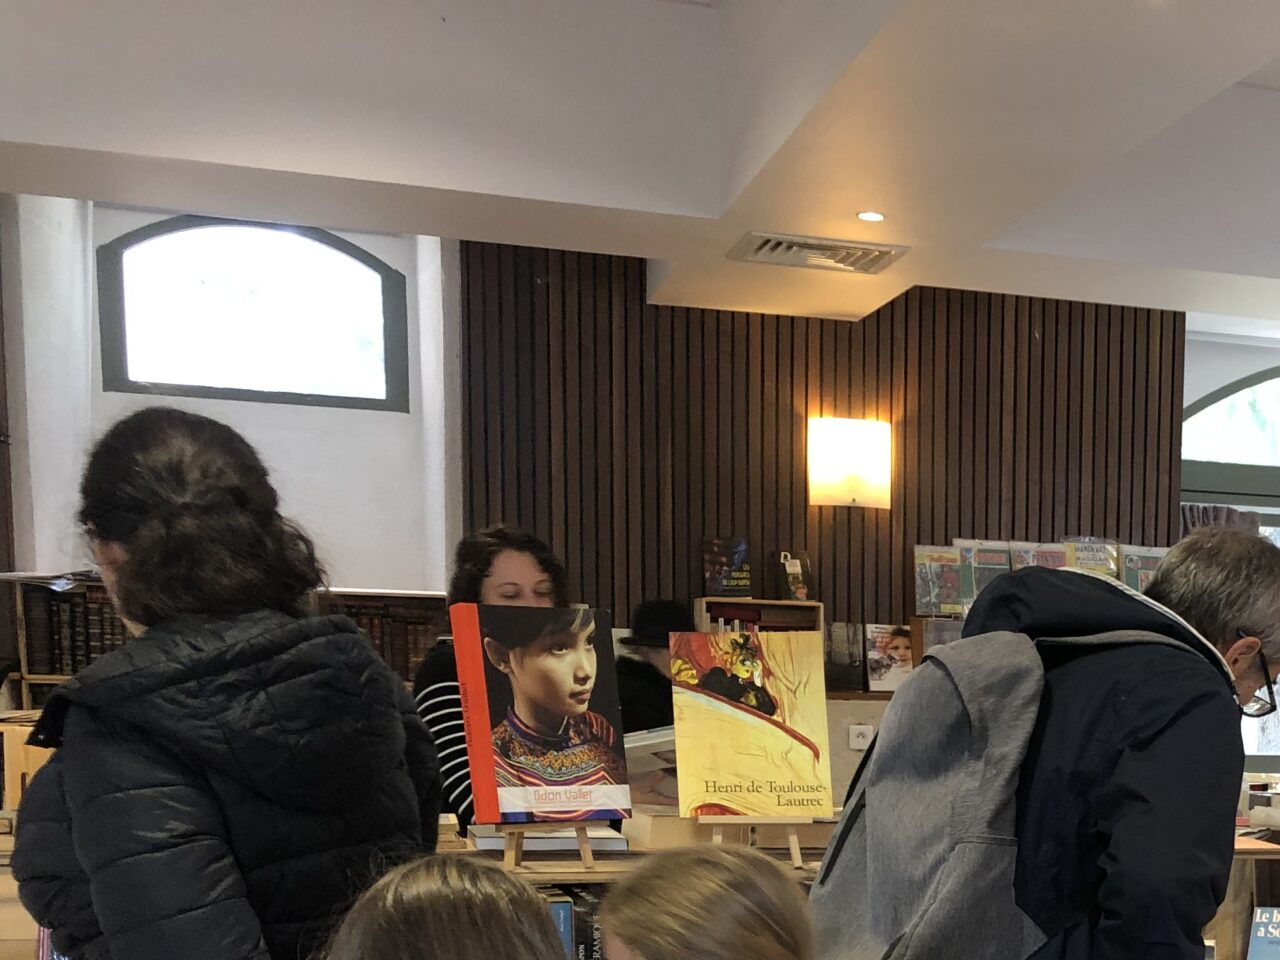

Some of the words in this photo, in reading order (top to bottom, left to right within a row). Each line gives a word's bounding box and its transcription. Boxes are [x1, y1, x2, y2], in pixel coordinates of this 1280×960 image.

[704, 780, 743, 793] Henri
[747, 781, 762, 793] de
[765, 780, 827, 793] Toulouse-
[534, 790, 563, 801] Odon
[565, 789, 593, 800] Vallet
[776, 795, 824, 807] Lautrec
[1256, 909, 1269, 923] Le
[1257, 924, 1265, 937] à
